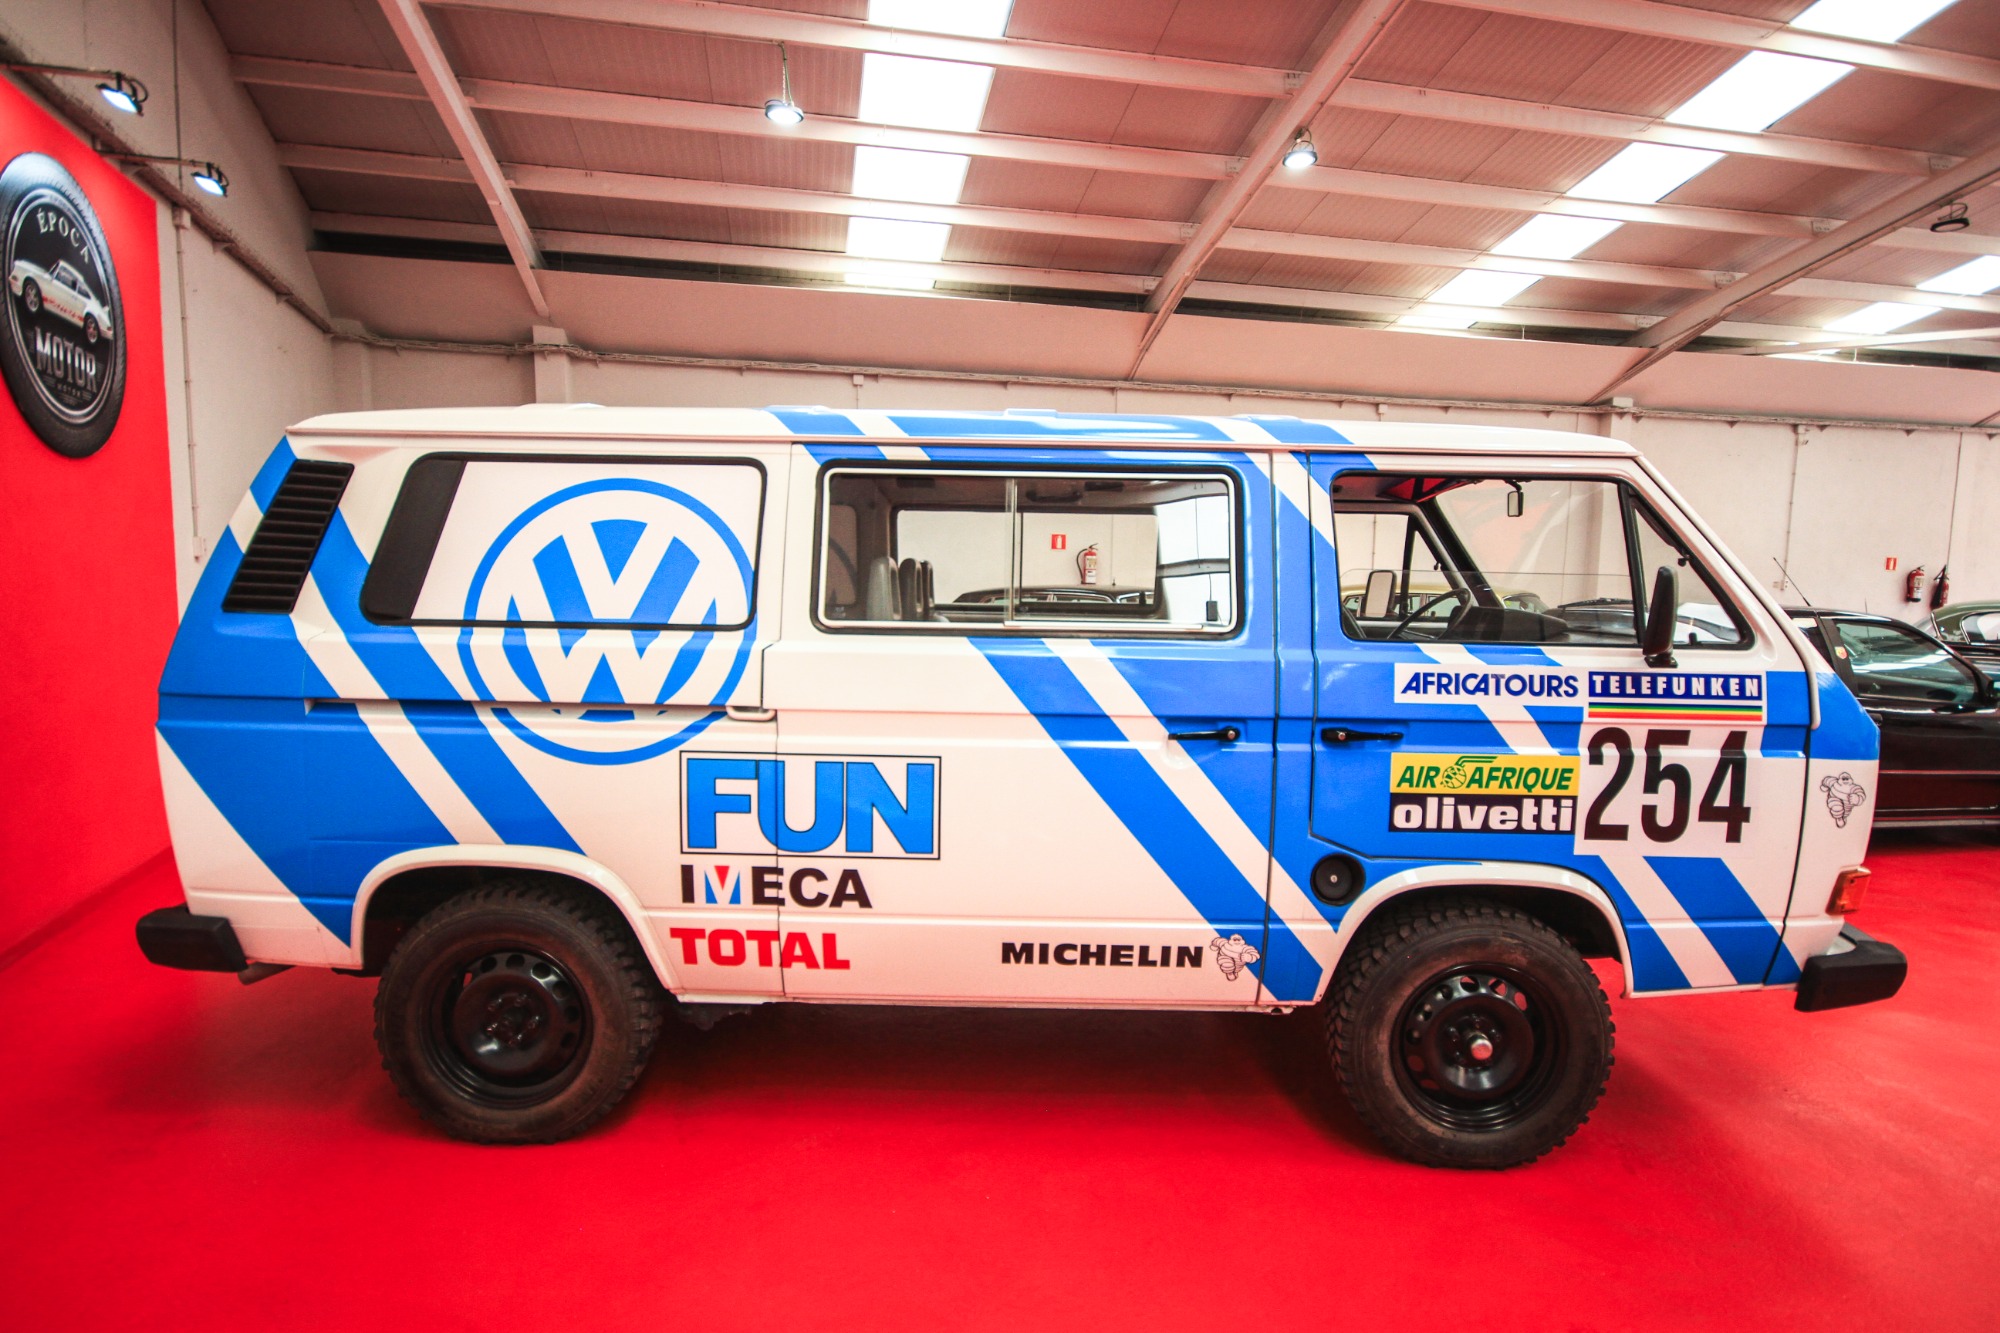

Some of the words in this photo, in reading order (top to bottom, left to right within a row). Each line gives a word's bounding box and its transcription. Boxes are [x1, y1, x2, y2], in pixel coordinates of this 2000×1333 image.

[37, 208, 89, 264] ÉPOCA
[35, 326, 97, 393] MOTOR
[485, 500, 735, 740] VW
[1401, 672, 1579, 698] AFRICATOURS
[1592, 674, 1760, 697] TELEFUNKEN
[1396, 765, 1441, 789] AIR
[1465, 766, 1575, 793] AFRIQUE
[1584, 727, 1752, 843] 254
[686, 757, 935, 855] FUN
[1393, 797, 1574, 832] olivetti
[680, 864, 873, 909] IMECA
[669, 927, 851, 970] TOTAL
[1001, 941, 1204, 969] MICHELIN
